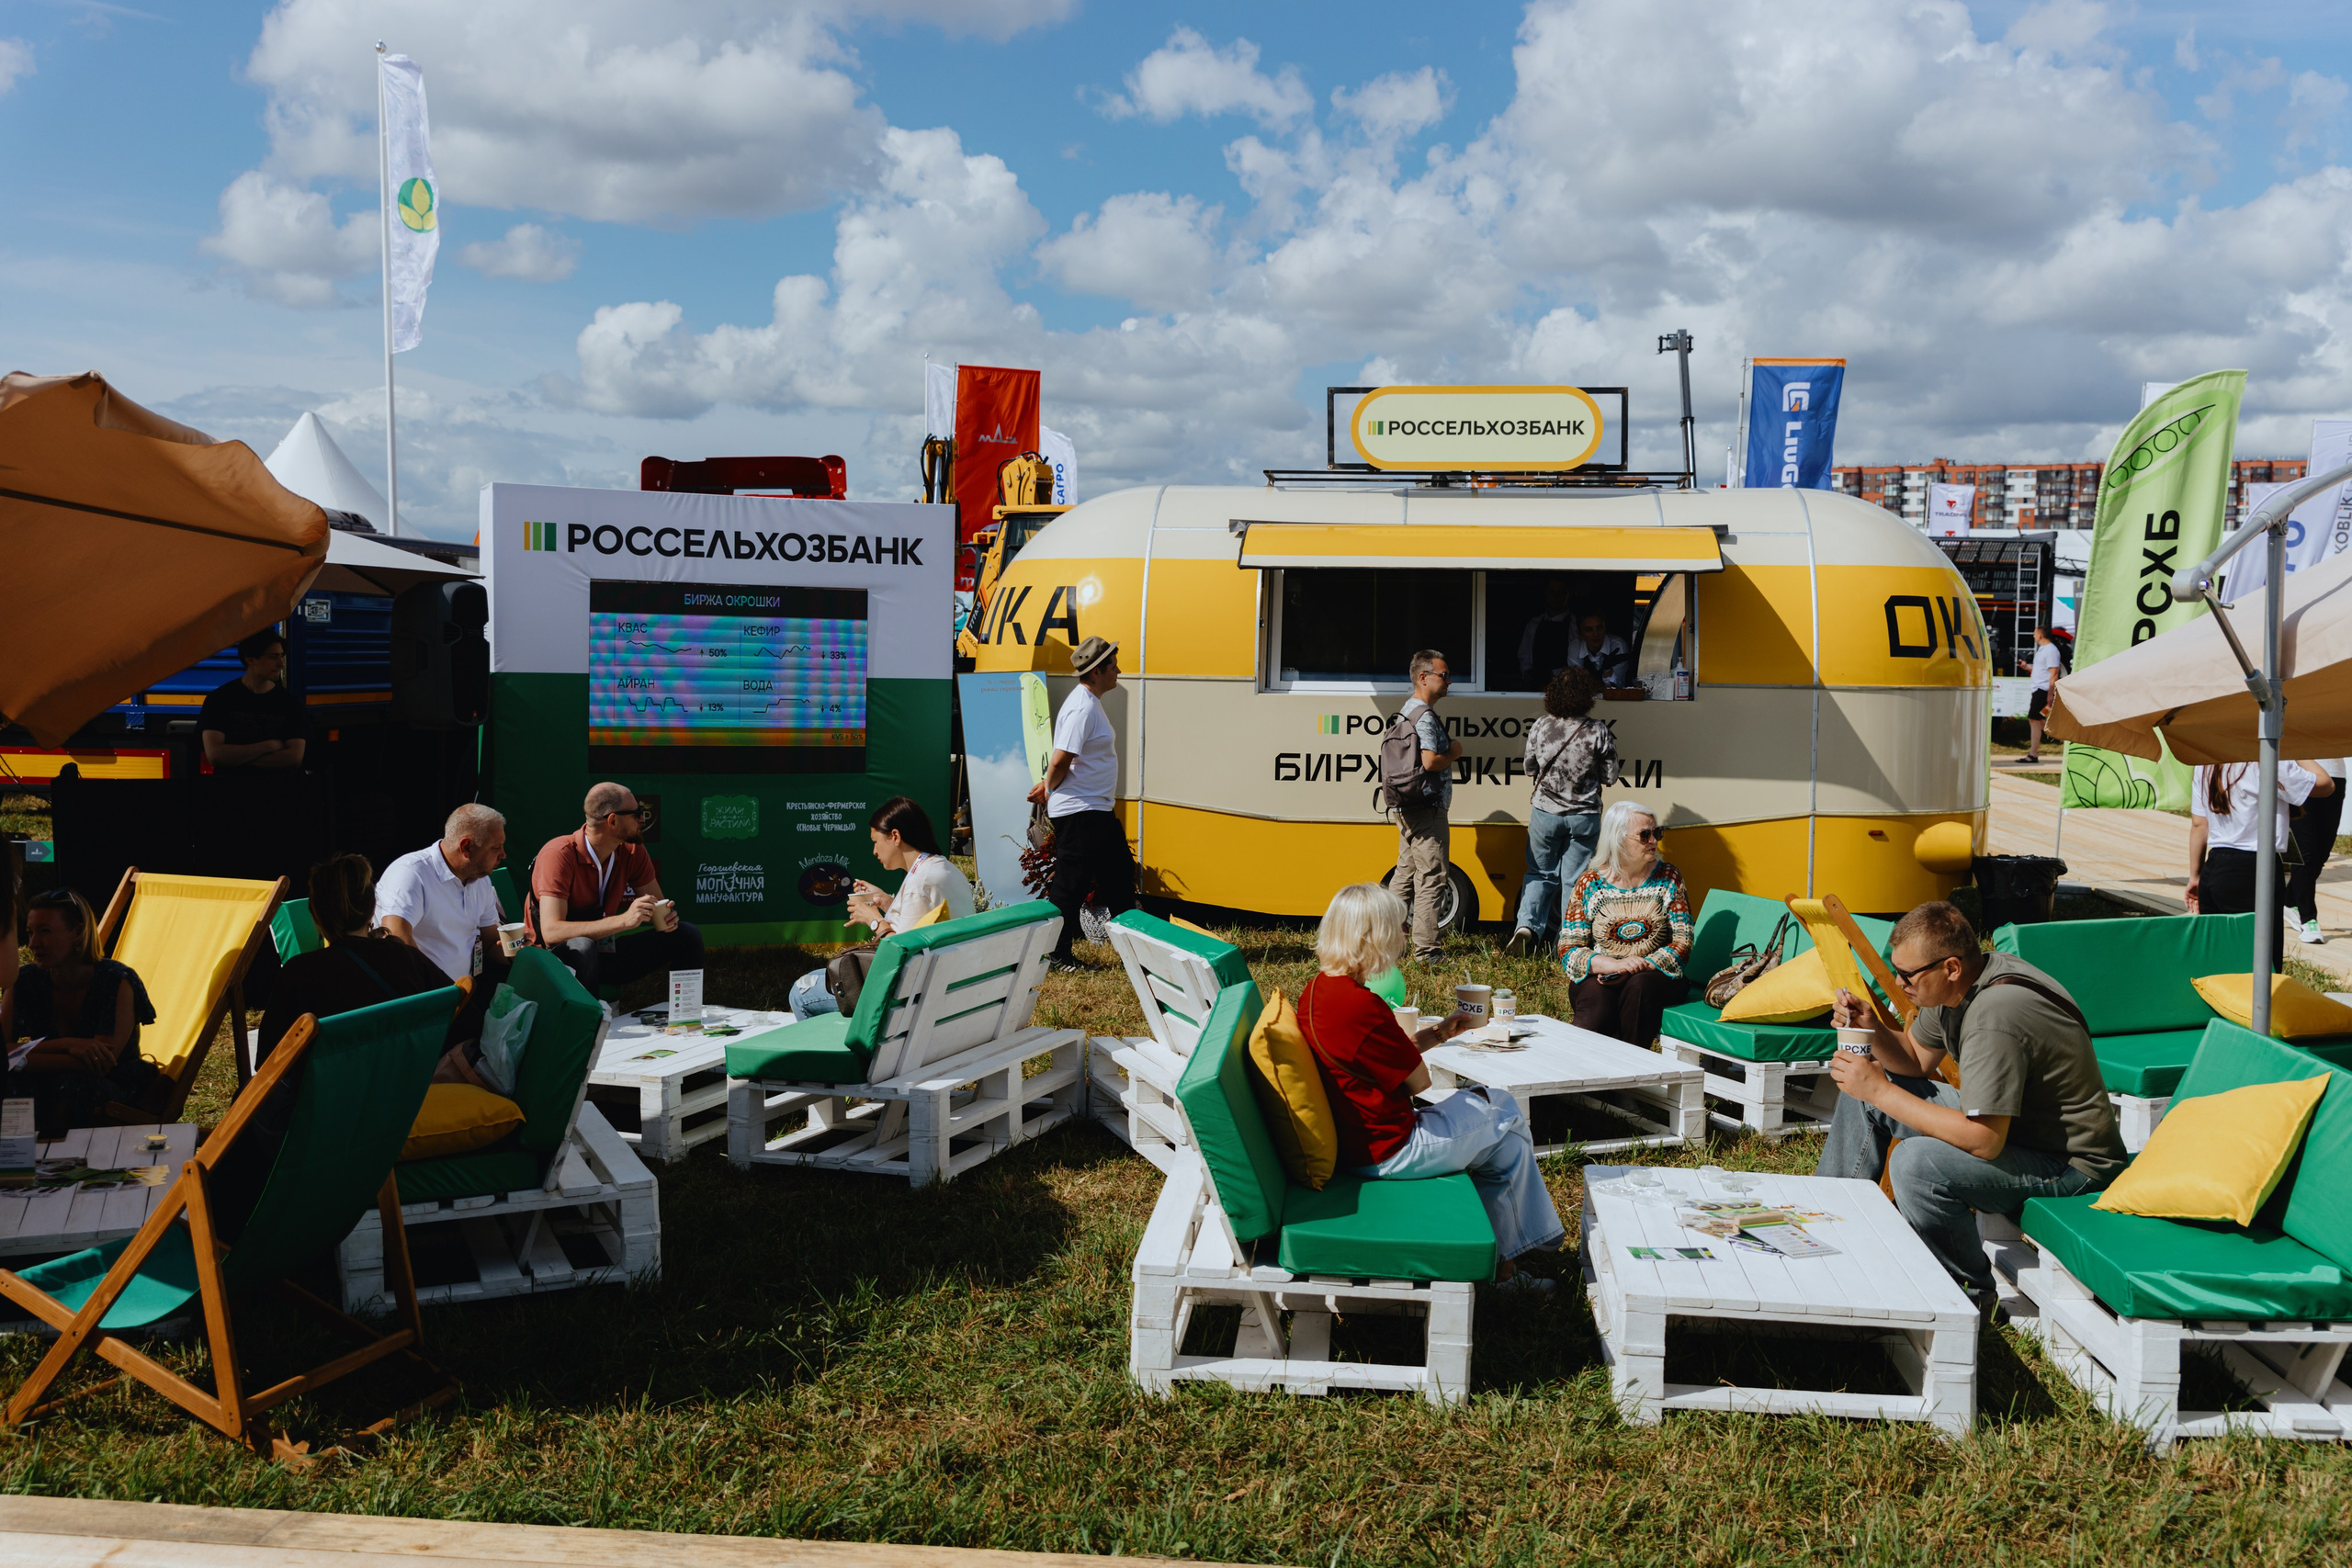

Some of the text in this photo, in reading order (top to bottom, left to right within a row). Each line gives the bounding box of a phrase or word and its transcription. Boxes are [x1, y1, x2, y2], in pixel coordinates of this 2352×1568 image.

[1388, 420, 1586, 436] РОССЕЛЬХОЗБАНК
[567, 523, 923, 566] РОССЕЛЬХОЗБАНК
[2131, 510, 2180, 648] РСХБ
[684, 593, 781, 608] БИРЖА ОКРОШКИ
[617, 622, 648, 634] КВАС
[743, 625, 781, 637] КЕФИР
[708, 649, 728, 659] 50%
[830, 650, 847, 660] 33%
[616, 675, 655, 689] АЙРАН
[742, 680, 774, 693] ВОДА
[708, 703, 724, 712] 13%
[829, 704, 842, 714] 4%
[1346, 715, 1618, 739] РОЛЬХОЗК
[1275, 752, 1383, 783] БИРЖ
[786, 801, 866, 810] КРЕСТЬЯНСКО-ФЕРМЕРСКОЕ
[810, 811, 842, 821] ХОЗЯЙСТВО
[798, 852, 851, 869] Mendoza Milk
[697, 861, 764, 874] Георгиевская
[695, 892, 764, 904] МАНУФАКТУРА
[1457, 999, 1484, 1014] РСХБ
